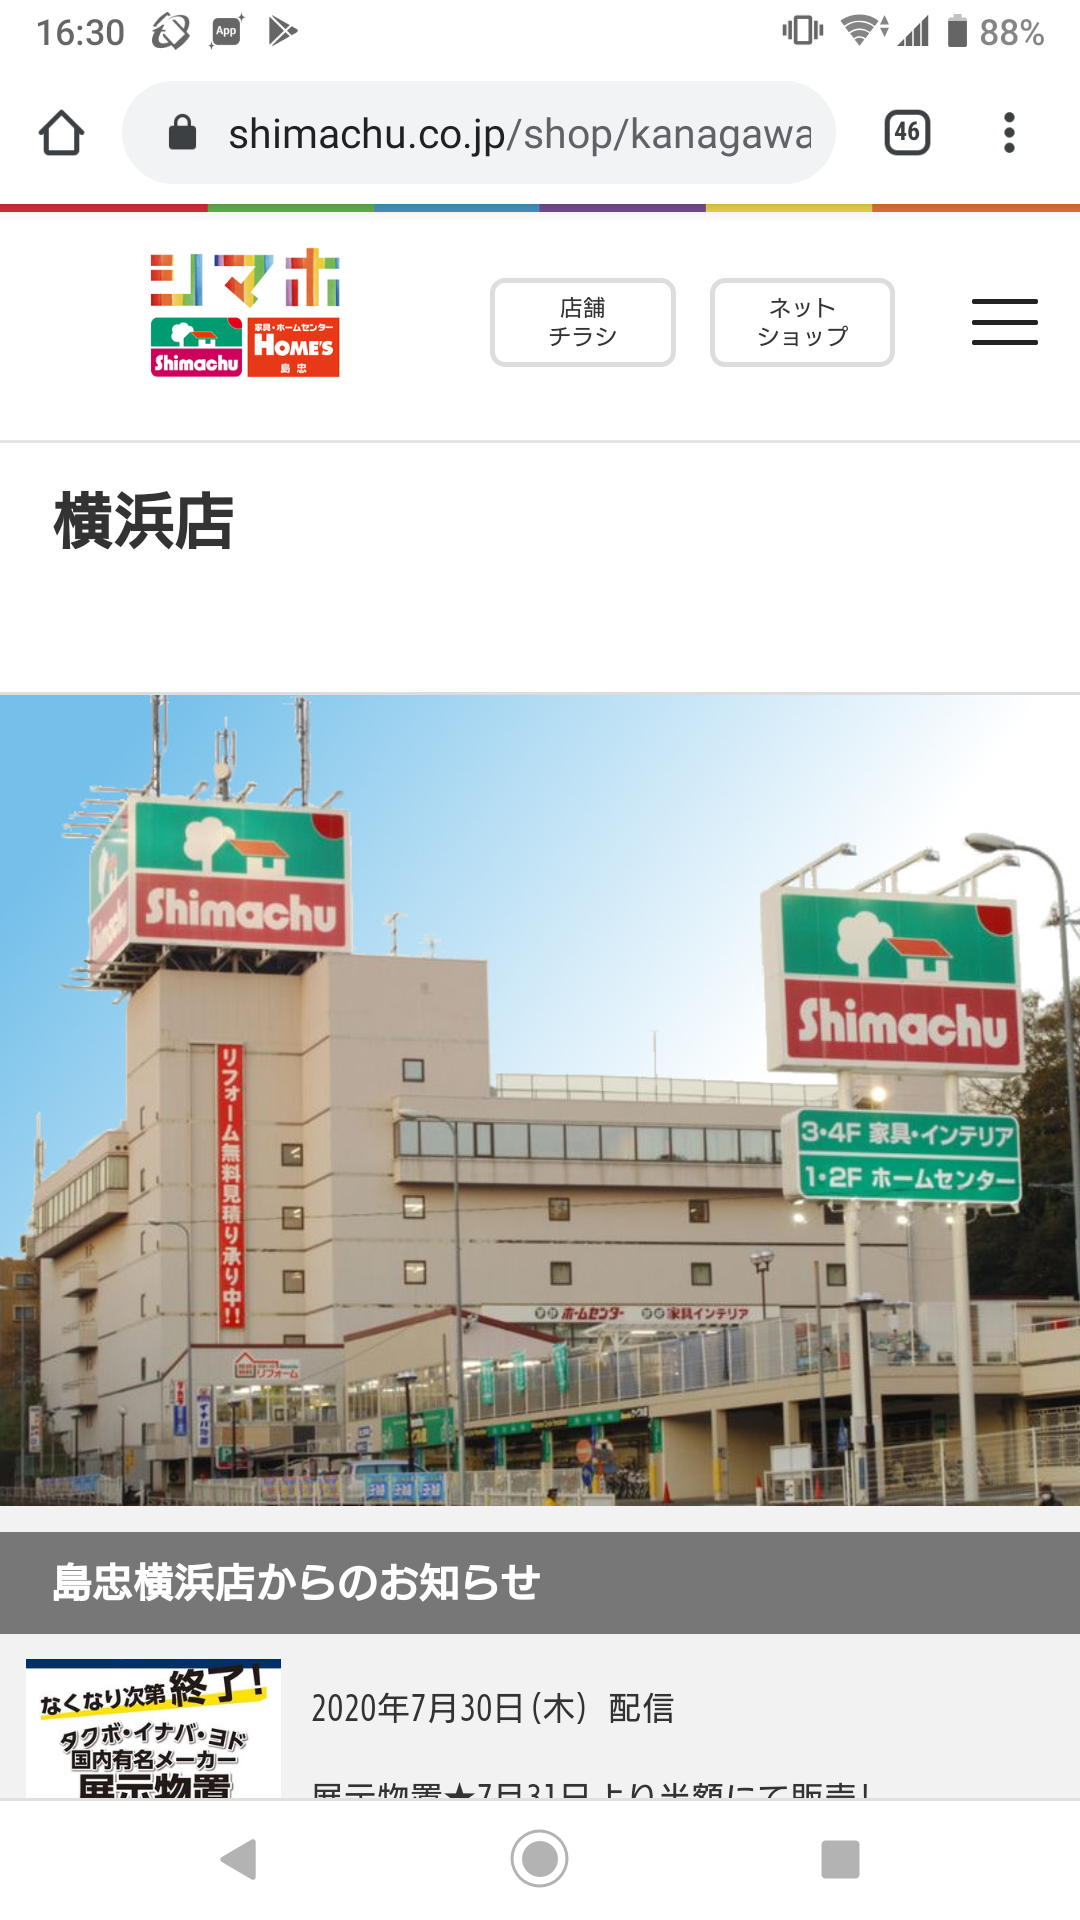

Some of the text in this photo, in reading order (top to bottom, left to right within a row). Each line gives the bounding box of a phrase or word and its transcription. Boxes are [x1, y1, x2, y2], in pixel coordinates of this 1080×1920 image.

[38, 19, 124, 45] 16:30
[215, 25, 237, 38] App
[980, 19, 1045, 46] 88%
[229, 116, 811, 158] shimachu.co.jp/shop/kanagawa
[894, 120, 920, 141] 46
[150, 247, 340, 308] シマホ
[560, 296, 606, 319] 店舗
[769, 297, 835, 319] ネット
[254, 323, 334, 332] 家具・ホームセンター
[549, 326, 617, 347] チラシ
[758, 325, 849, 347] ショップ
[254, 333, 334, 356] HOME'S
[154, 354, 239, 372] Shimachu
[53, 490, 233, 550] 横浜店
[145, 887, 337, 933] Shimachu
[798, 997, 1008, 1049] Shimachu
[869, 1121, 1014, 1148] 家具・インテリア
[221, 1048, 242, 1324] リフォーム無料見積り承り中!!
[871, 1167, 1017, 1192] ホームセンター
[561, 1306, 625, 1321] ホームセンター
[666, 1307, 749, 1321] 家具インテリア
[256, 1369, 299, 1379] リフォーム
[53, 1561, 541, 1602] 島忠横浜店からのお知らせ
[60, 1721, 248, 1752] タクボ・イナバ・ヨド
[71, 1750, 238, 1771] 国内有名メーカー
[79, 1773, 232, 1798] 展示物置
